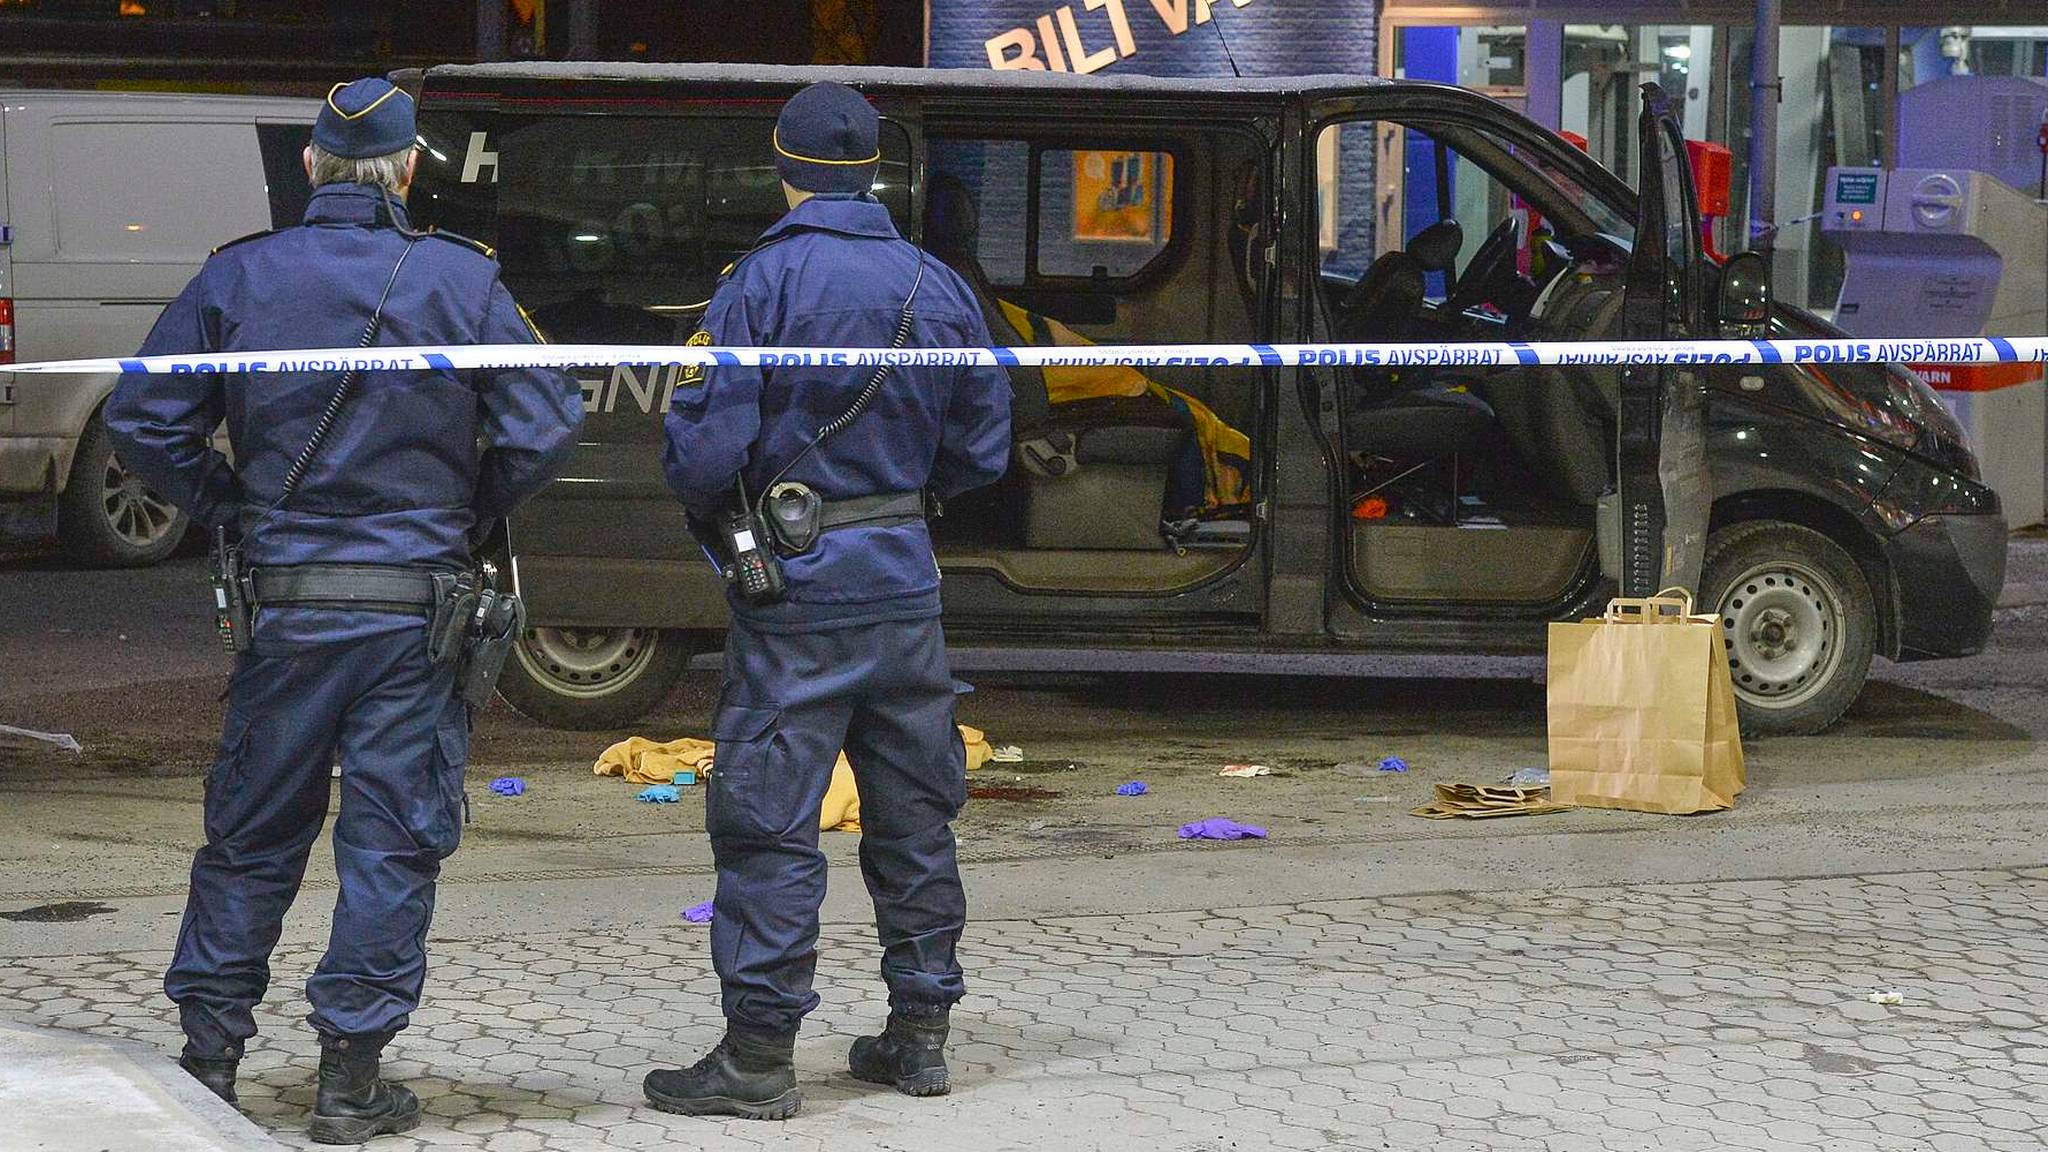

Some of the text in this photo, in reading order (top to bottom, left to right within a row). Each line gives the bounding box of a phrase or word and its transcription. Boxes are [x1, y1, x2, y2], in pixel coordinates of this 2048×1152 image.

[1299, 345, 1503, 365] POLIS AVSPÄRRAT
[1795, 340, 1983, 361] POLIS AVSPÄRRAT
